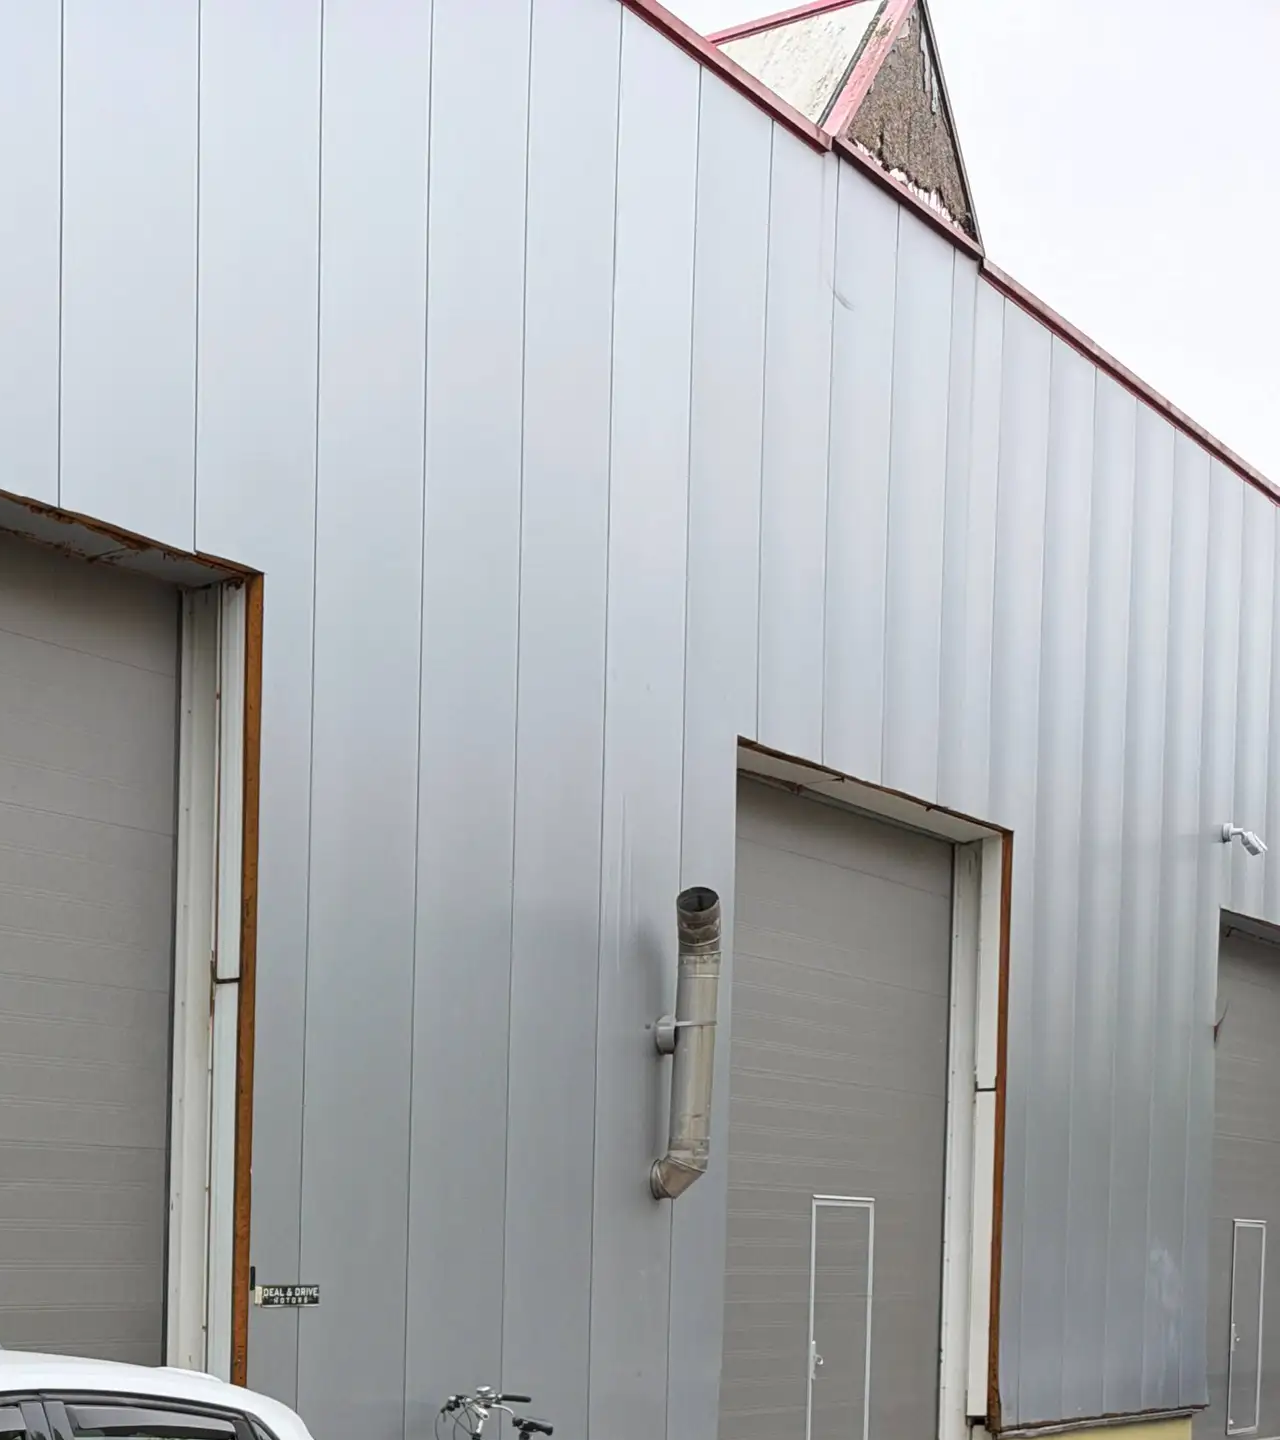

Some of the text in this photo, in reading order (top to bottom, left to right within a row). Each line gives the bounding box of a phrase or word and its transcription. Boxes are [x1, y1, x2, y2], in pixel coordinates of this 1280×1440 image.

[263, 1287, 319, 1297] DEAL & DRIVE
